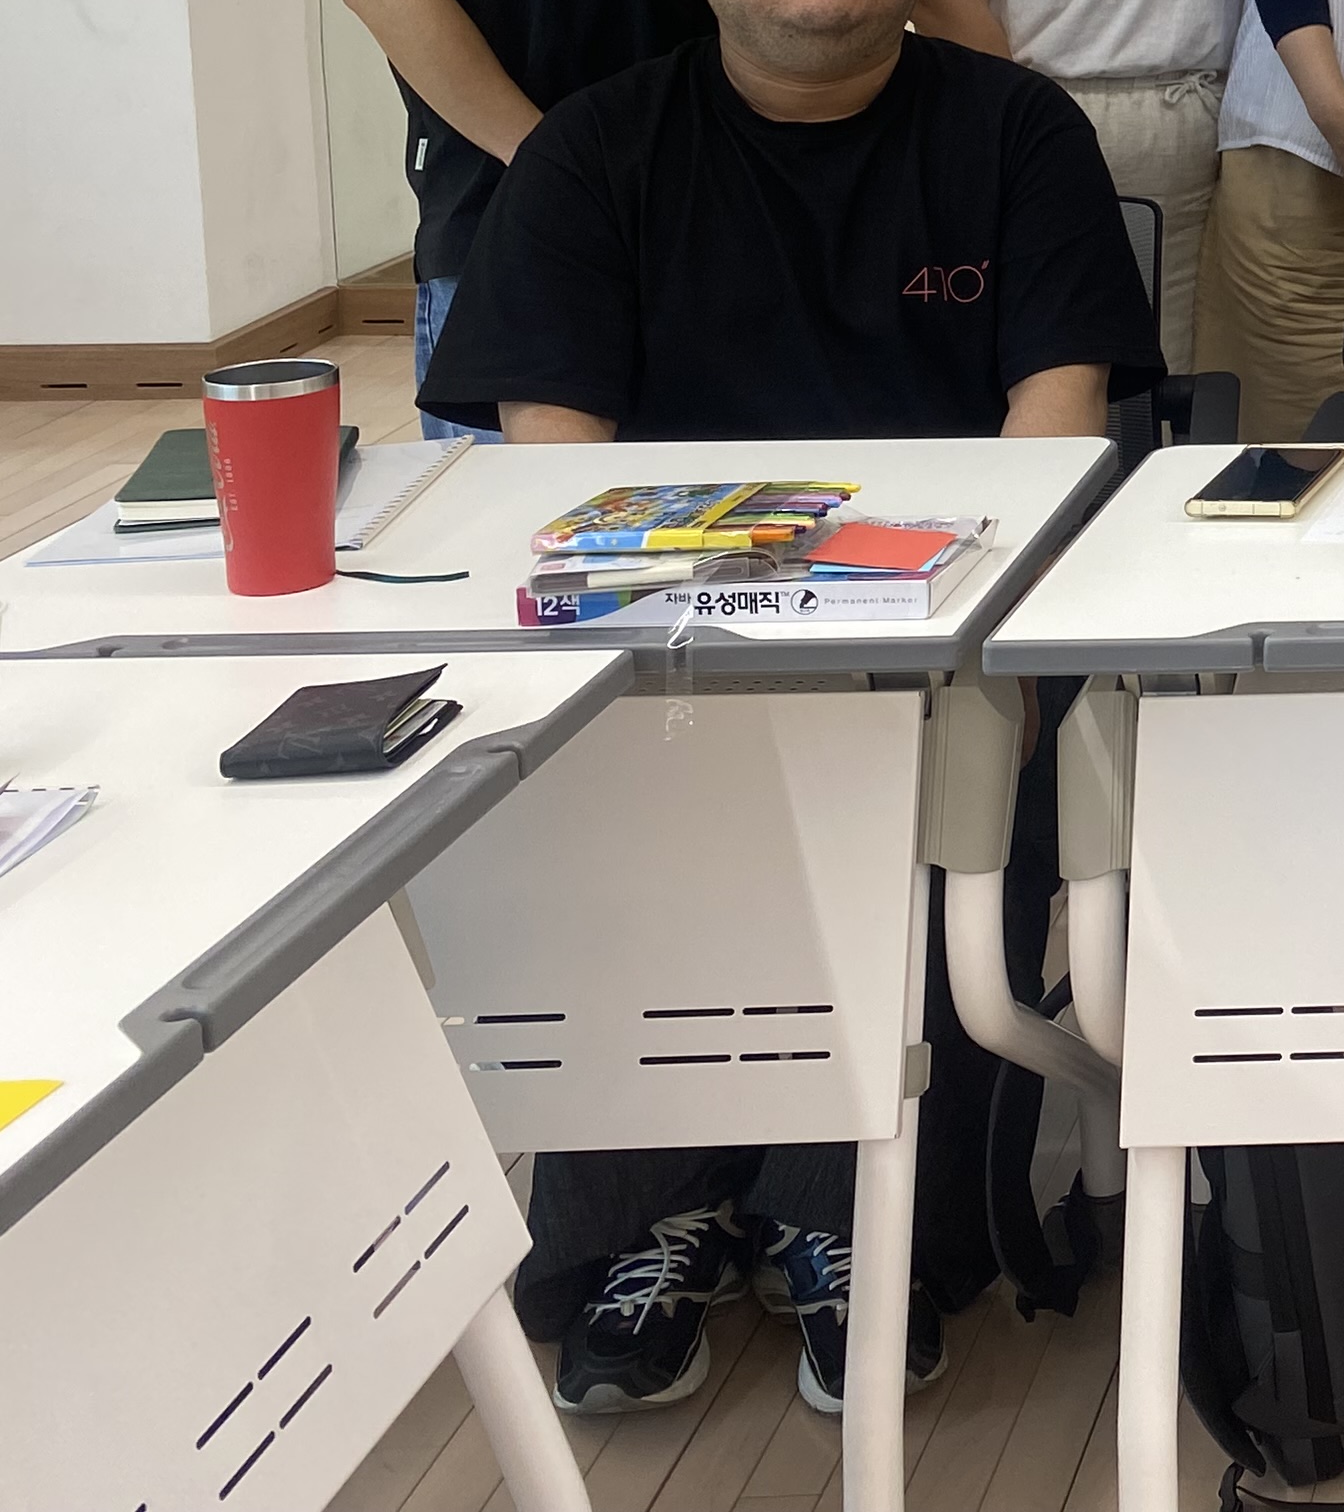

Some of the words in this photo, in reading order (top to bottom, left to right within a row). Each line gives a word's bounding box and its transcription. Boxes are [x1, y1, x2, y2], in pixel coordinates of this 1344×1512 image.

[535, 594, 580, 617] 12색
[665, 591, 692, 606] 자바
[824, 597, 879, 606] Permanent
[882, 597, 918, 605] Marker
